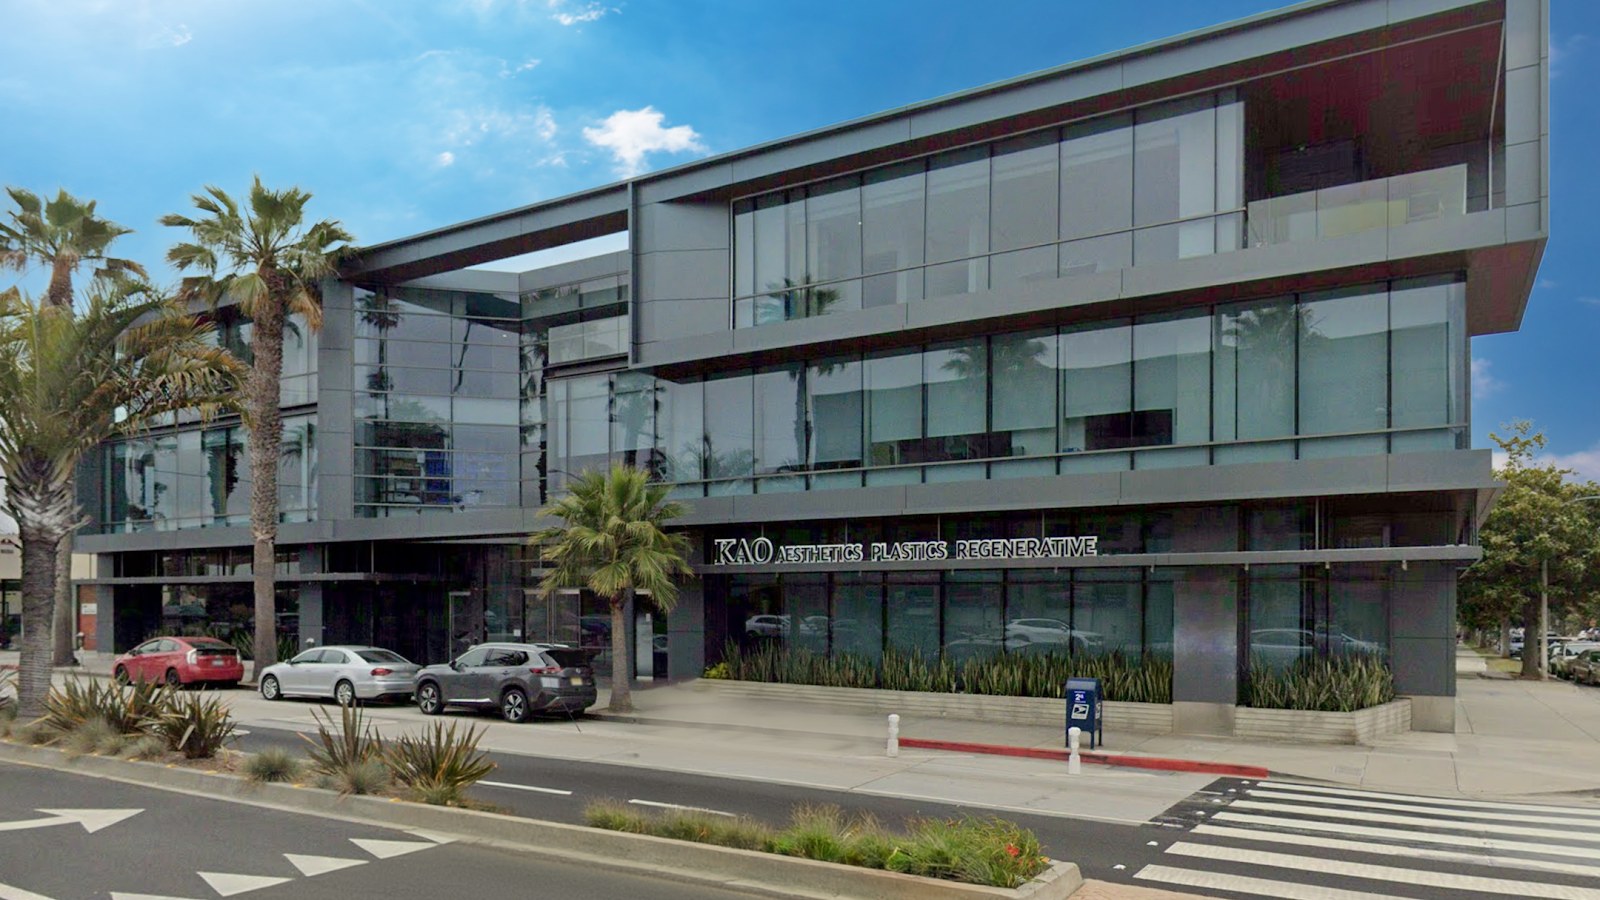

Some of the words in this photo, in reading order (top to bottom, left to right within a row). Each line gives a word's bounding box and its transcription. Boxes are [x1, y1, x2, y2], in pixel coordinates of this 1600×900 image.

[714, 537, 773, 565] KAO
[775, 543, 863, 564] AESTHETICS
[871, 541, 948, 562] PLASTICS
[956, 536, 1098, 560] REGENERATIVE
